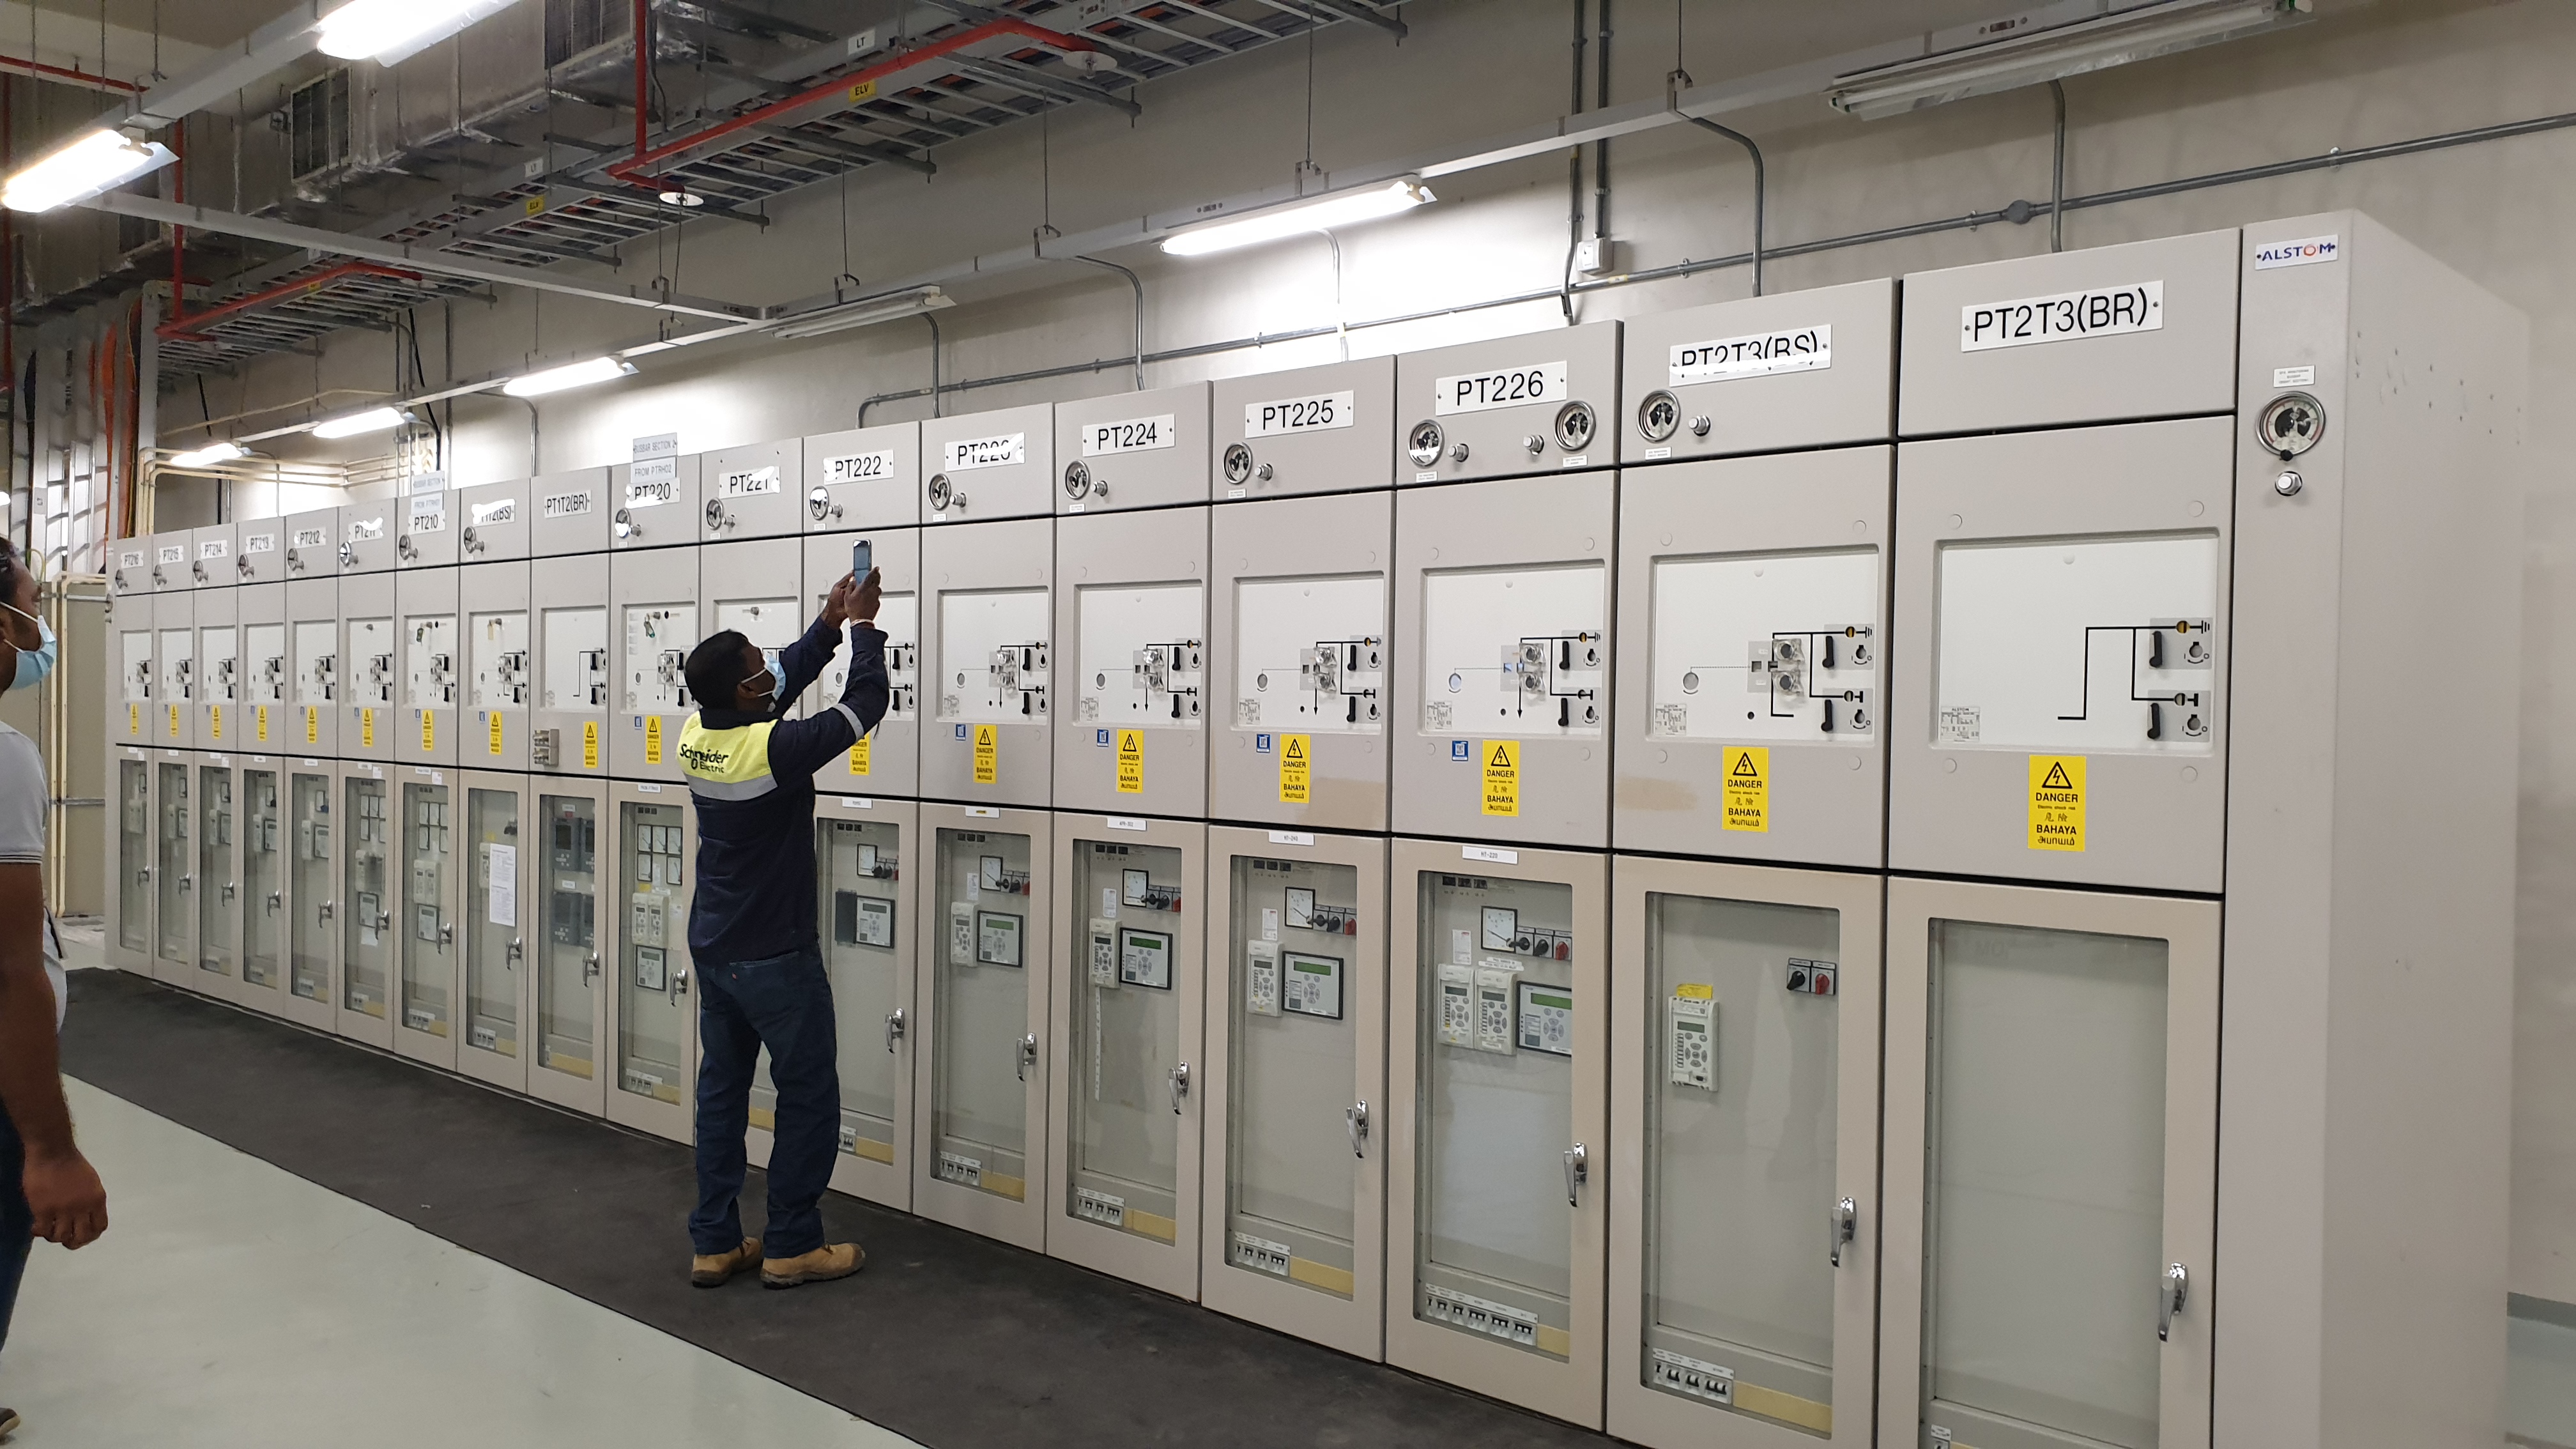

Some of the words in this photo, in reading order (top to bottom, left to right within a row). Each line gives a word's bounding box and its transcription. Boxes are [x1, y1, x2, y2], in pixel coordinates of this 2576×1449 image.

[857, 37, 865, 48] LT
[855, 84, 869, 96] ELV
[2262, 243, 2331, 261] ALSTOM
[1974, 287, 2147, 342] PT2T3(BR)
[1457, 371, 1544, 406] PT226
[1263, 399, 1333, 430] PT225
[1098, 422, 1157, 450] PT224
[634, 466, 649, 477] FROM
[835, 456, 881, 479] PT222
[547, 493, 587, 514] PT1T2(BR)
[415, 514, 438, 531] PT210
[300, 530, 319, 545] PT212
[204, 543, 222, 556] PT214
[680, 744, 729, 763] Schneider
[1487, 769, 1514, 778] DANGER
[1284, 783, 1305, 792] BAHAYA
[1728, 779, 1762, 788] DANGER
[1487, 795, 1514, 804] BAHAYA
[2035, 792, 2078, 803] DANGER
[1728, 808, 1761, 817] BAHAYA
[2037, 824, 2076, 835] BAHAYA
